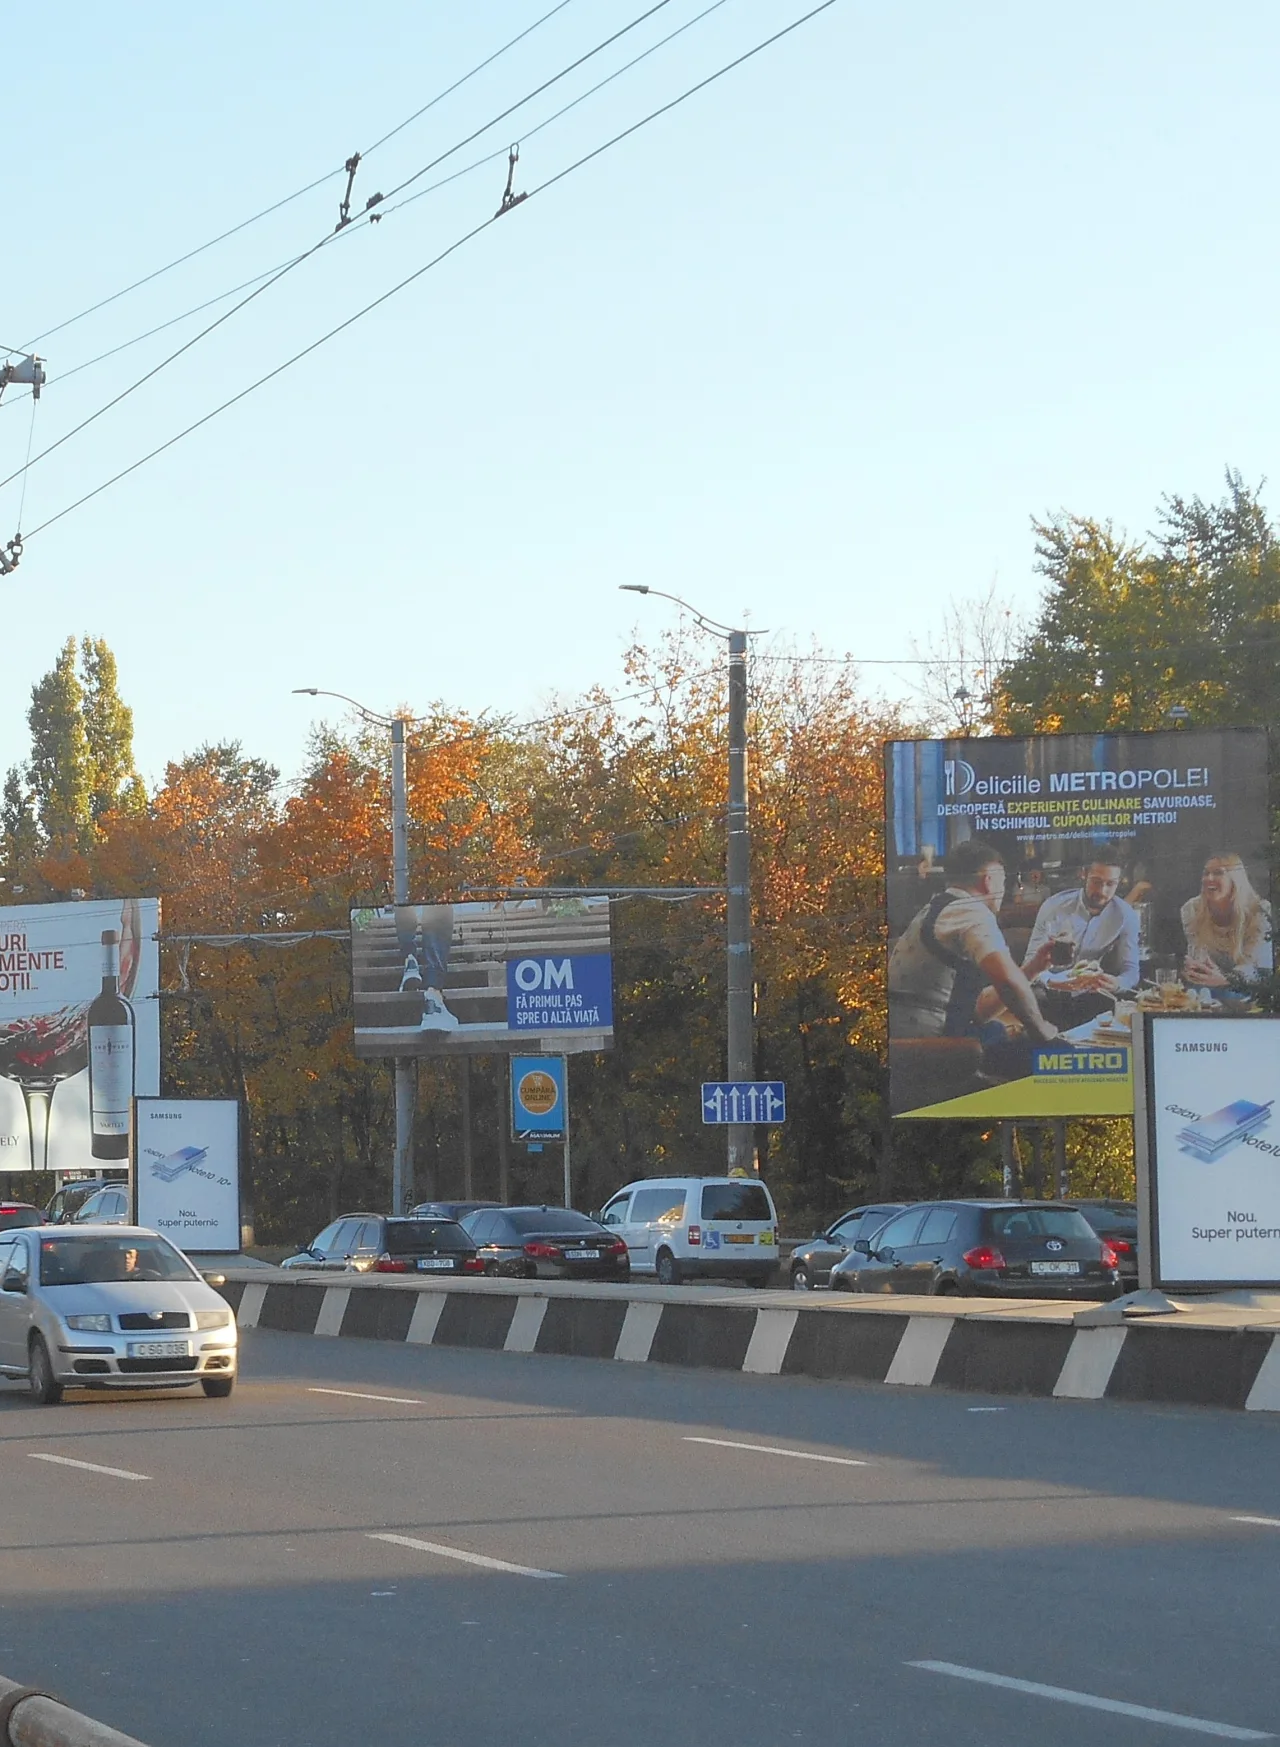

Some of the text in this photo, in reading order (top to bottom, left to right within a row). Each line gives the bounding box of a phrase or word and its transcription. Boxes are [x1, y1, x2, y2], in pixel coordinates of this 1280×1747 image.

[937, 800, 1005, 816] DESCOPERĂ
[1082, 798, 1142, 811] CULINARE
[1143, 795, 1216, 809] SAVUROASE,
[975, 812, 1177, 830] ÎN SCHIMBUL CUPOANELOR METRO!
[515, 959, 574, 991] OM
[516, 993, 583, 1008] FĂ PRIMUL PAS
[517, 1006, 599, 1025] SPRE O ALTĂ VIAȚĂ
[1175, 1043, 1228, 1052] SAMSUNG
[1039, 1053, 1123, 1070] METRO
[1165, 1104, 1202, 1122] Galaxy
[158, 1219, 218, 1228] Super puternic
[1227, 1211, 1257, 1223] Nou.
[1192, 1227, 1231, 1242] Super
